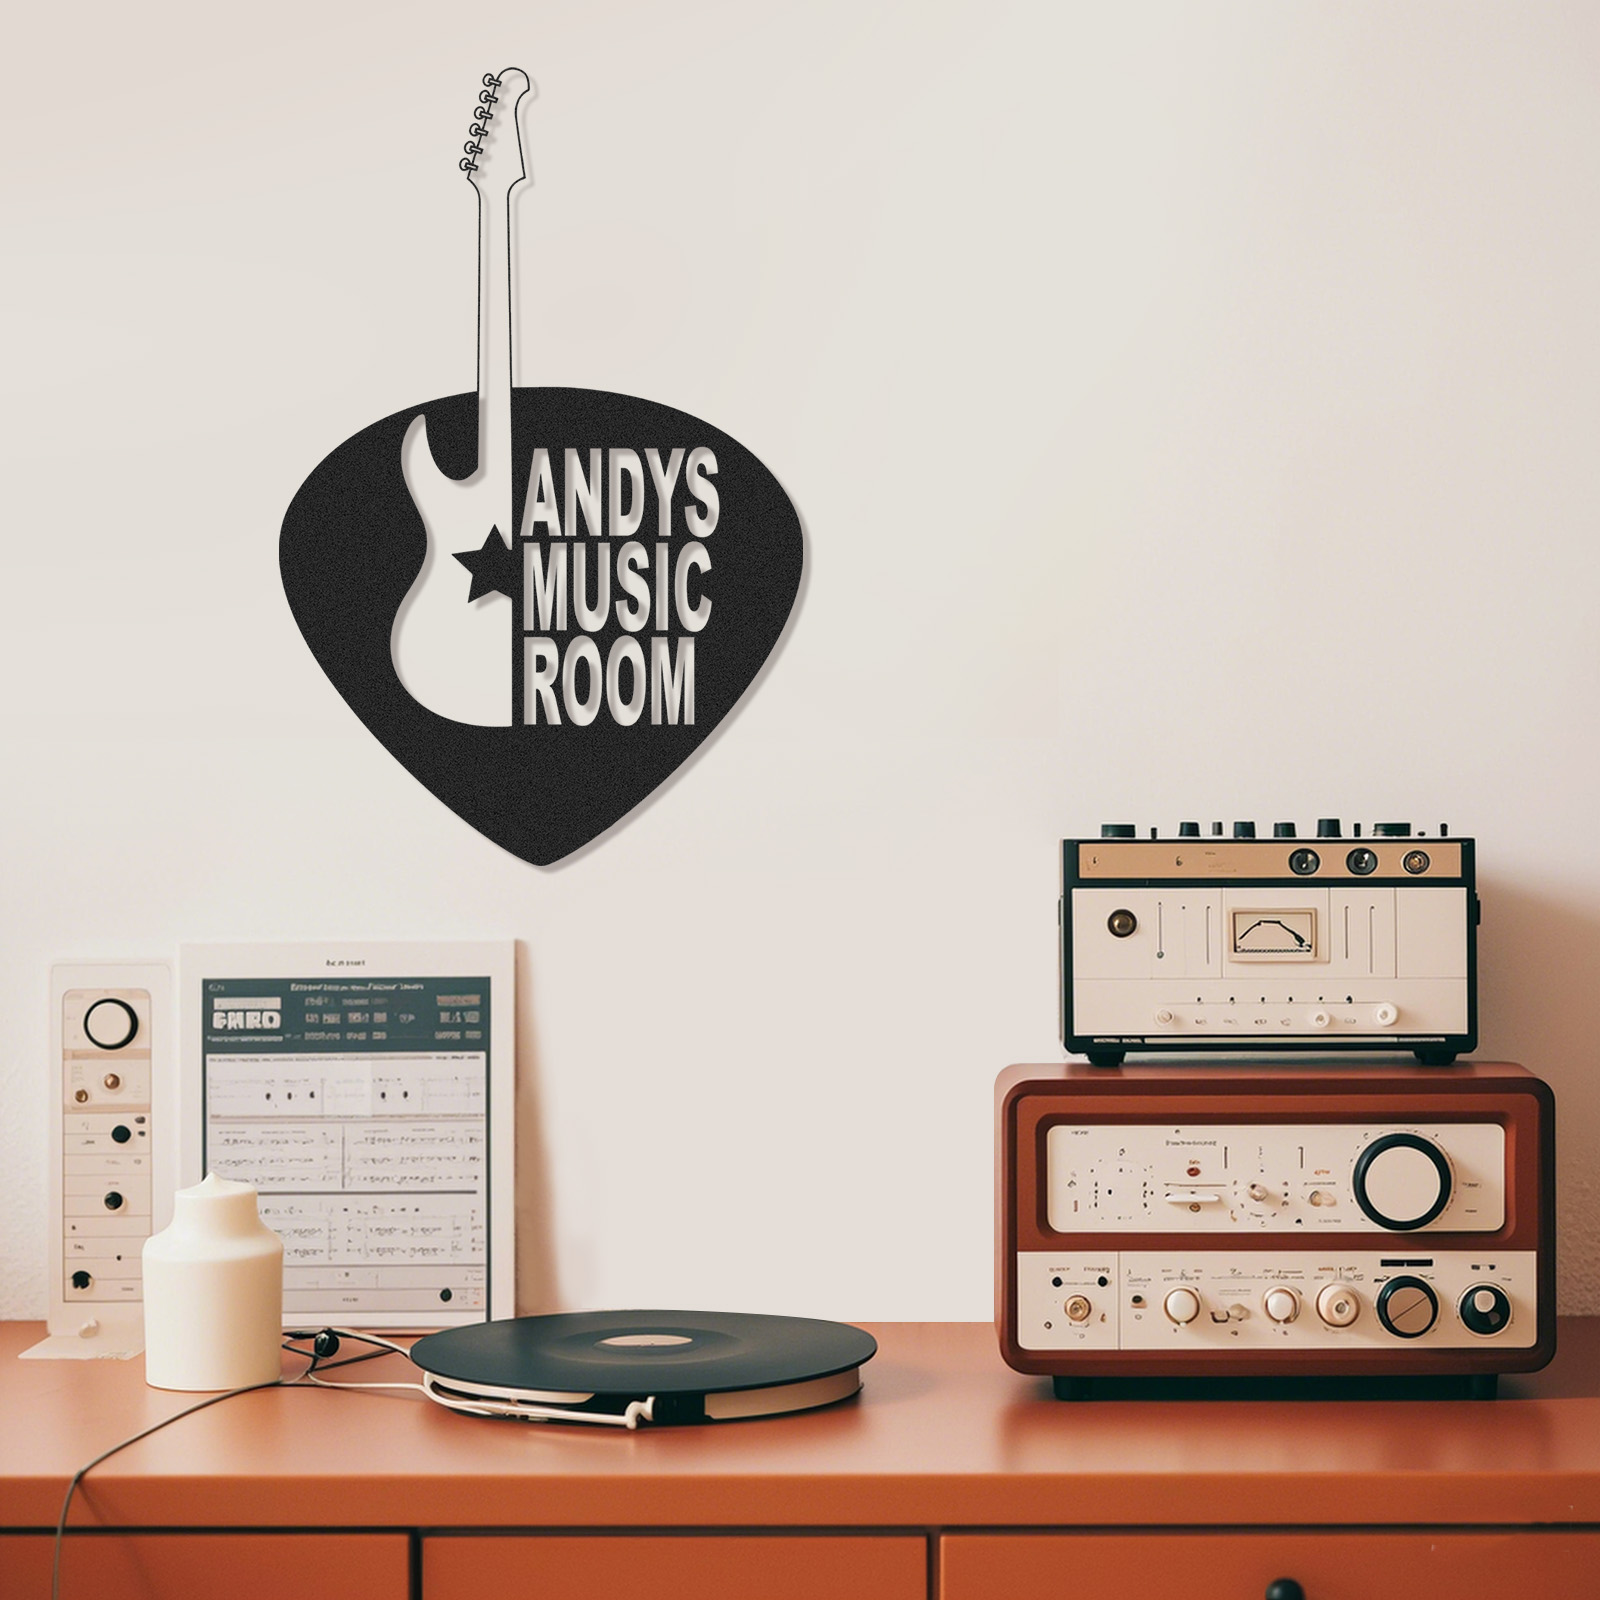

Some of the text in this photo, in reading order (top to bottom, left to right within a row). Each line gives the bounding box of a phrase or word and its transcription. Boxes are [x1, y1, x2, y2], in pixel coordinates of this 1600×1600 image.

[520, 446, 720, 538] ANDYS
[523, 541, 713, 633] MUSIC
[523, 635, 695, 727] ROOM
